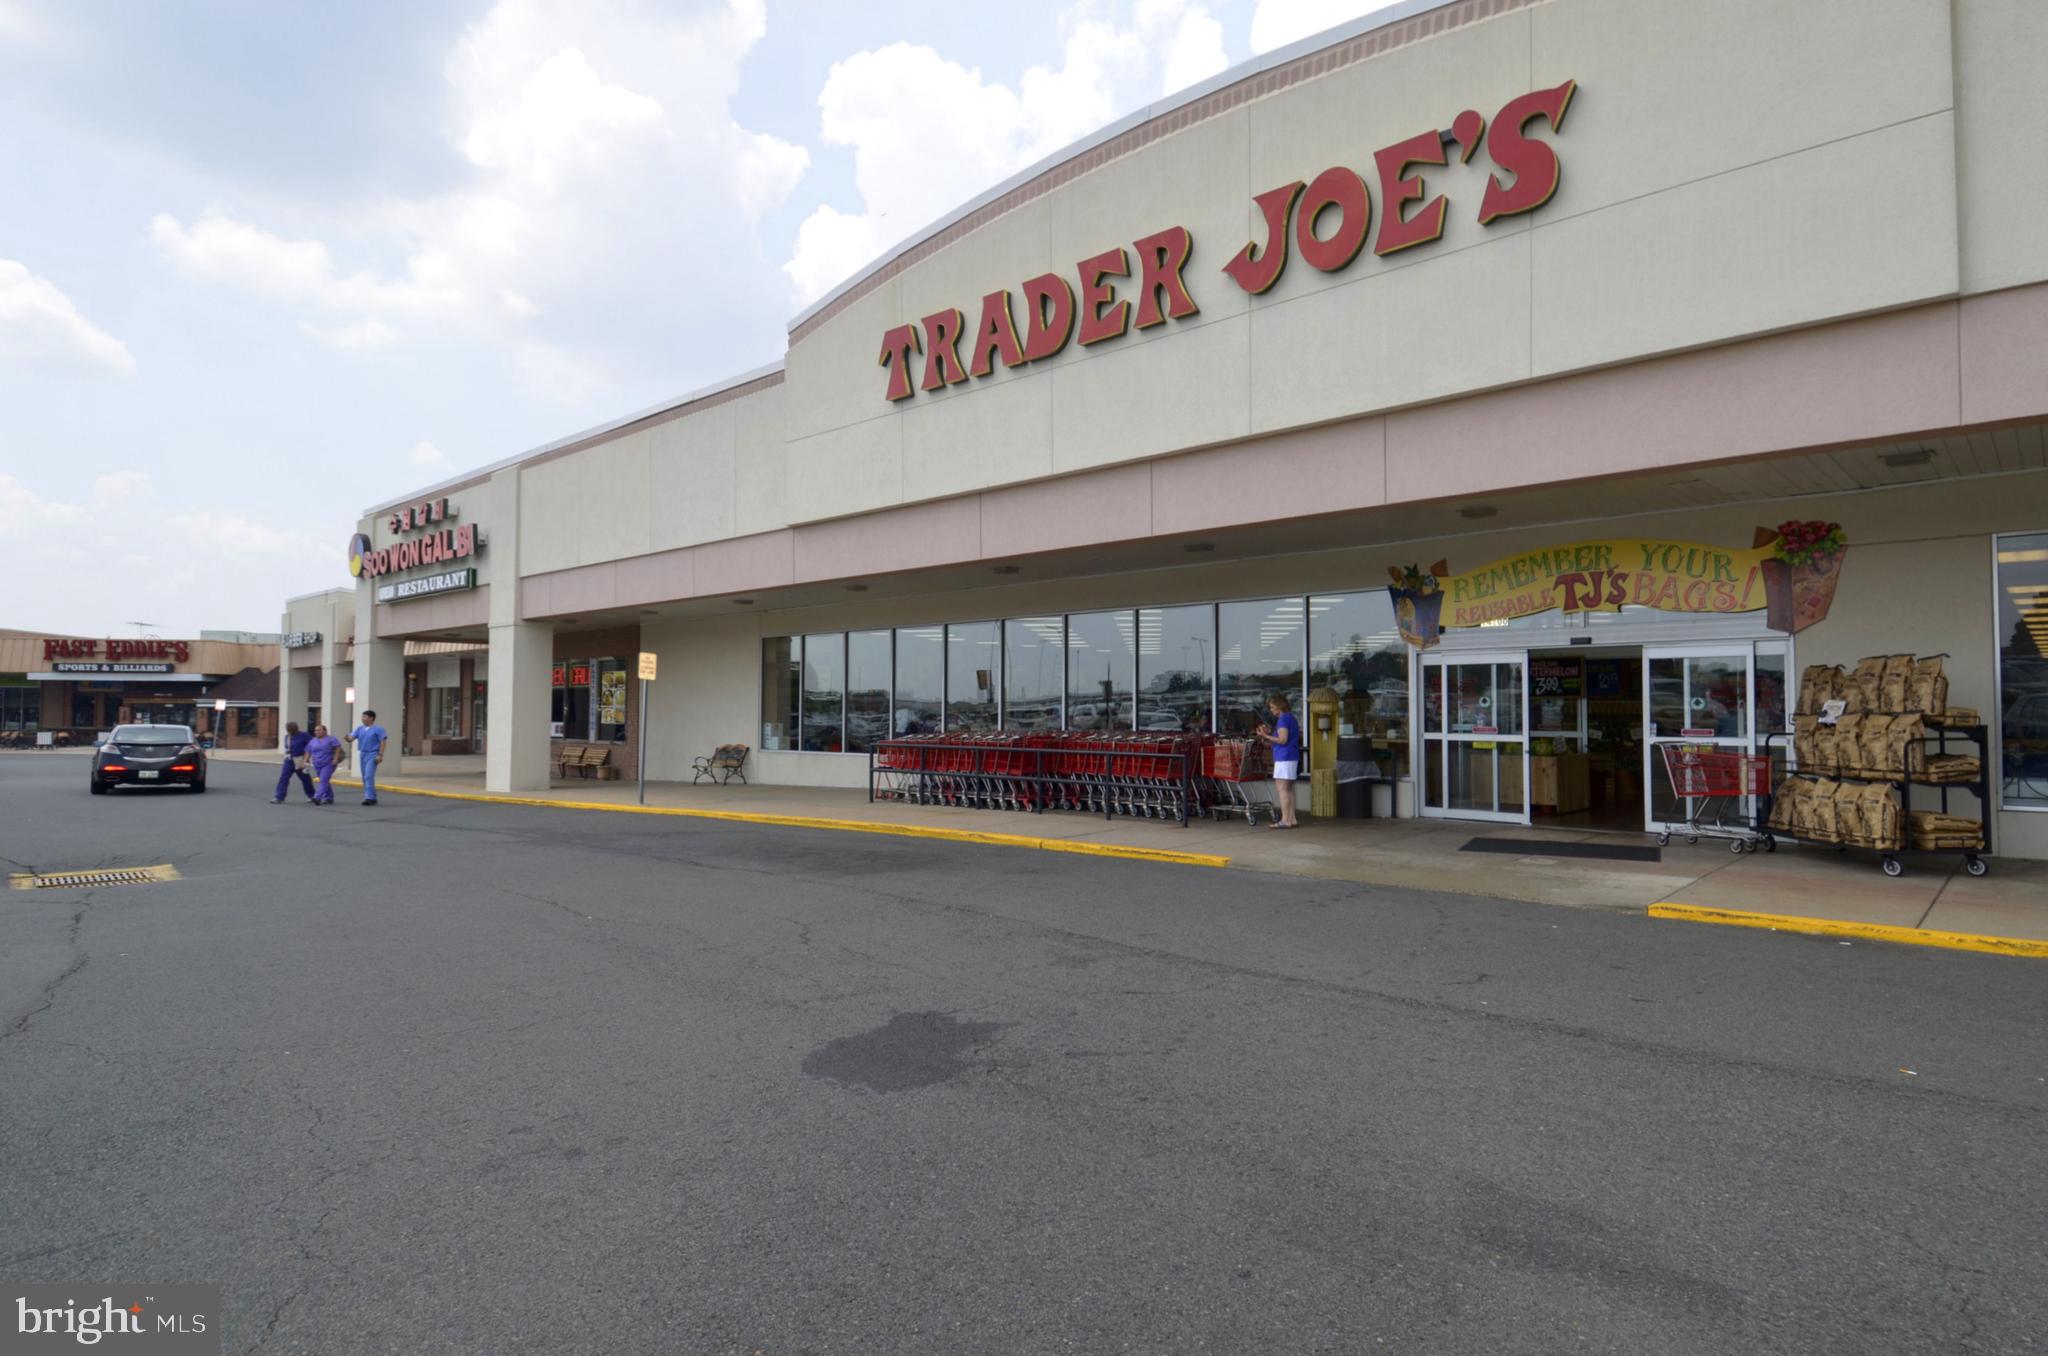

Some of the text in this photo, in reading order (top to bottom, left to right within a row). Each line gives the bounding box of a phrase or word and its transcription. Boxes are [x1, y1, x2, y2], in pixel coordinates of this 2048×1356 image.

[878, 79, 1577, 402] TRADER JOE'S
[398, 571, 466, 596] RESTAURANT
[1454, 543, 1739, 603] REMEMBER YOUR
[1455, 588, 1556, 624] REUSABLE
[1632, 565, 1761, 610] BAGS!
[44, 639, 189, 663] FAST EDDIE'S
[113, 664, 167, 672] BILLIARDS
